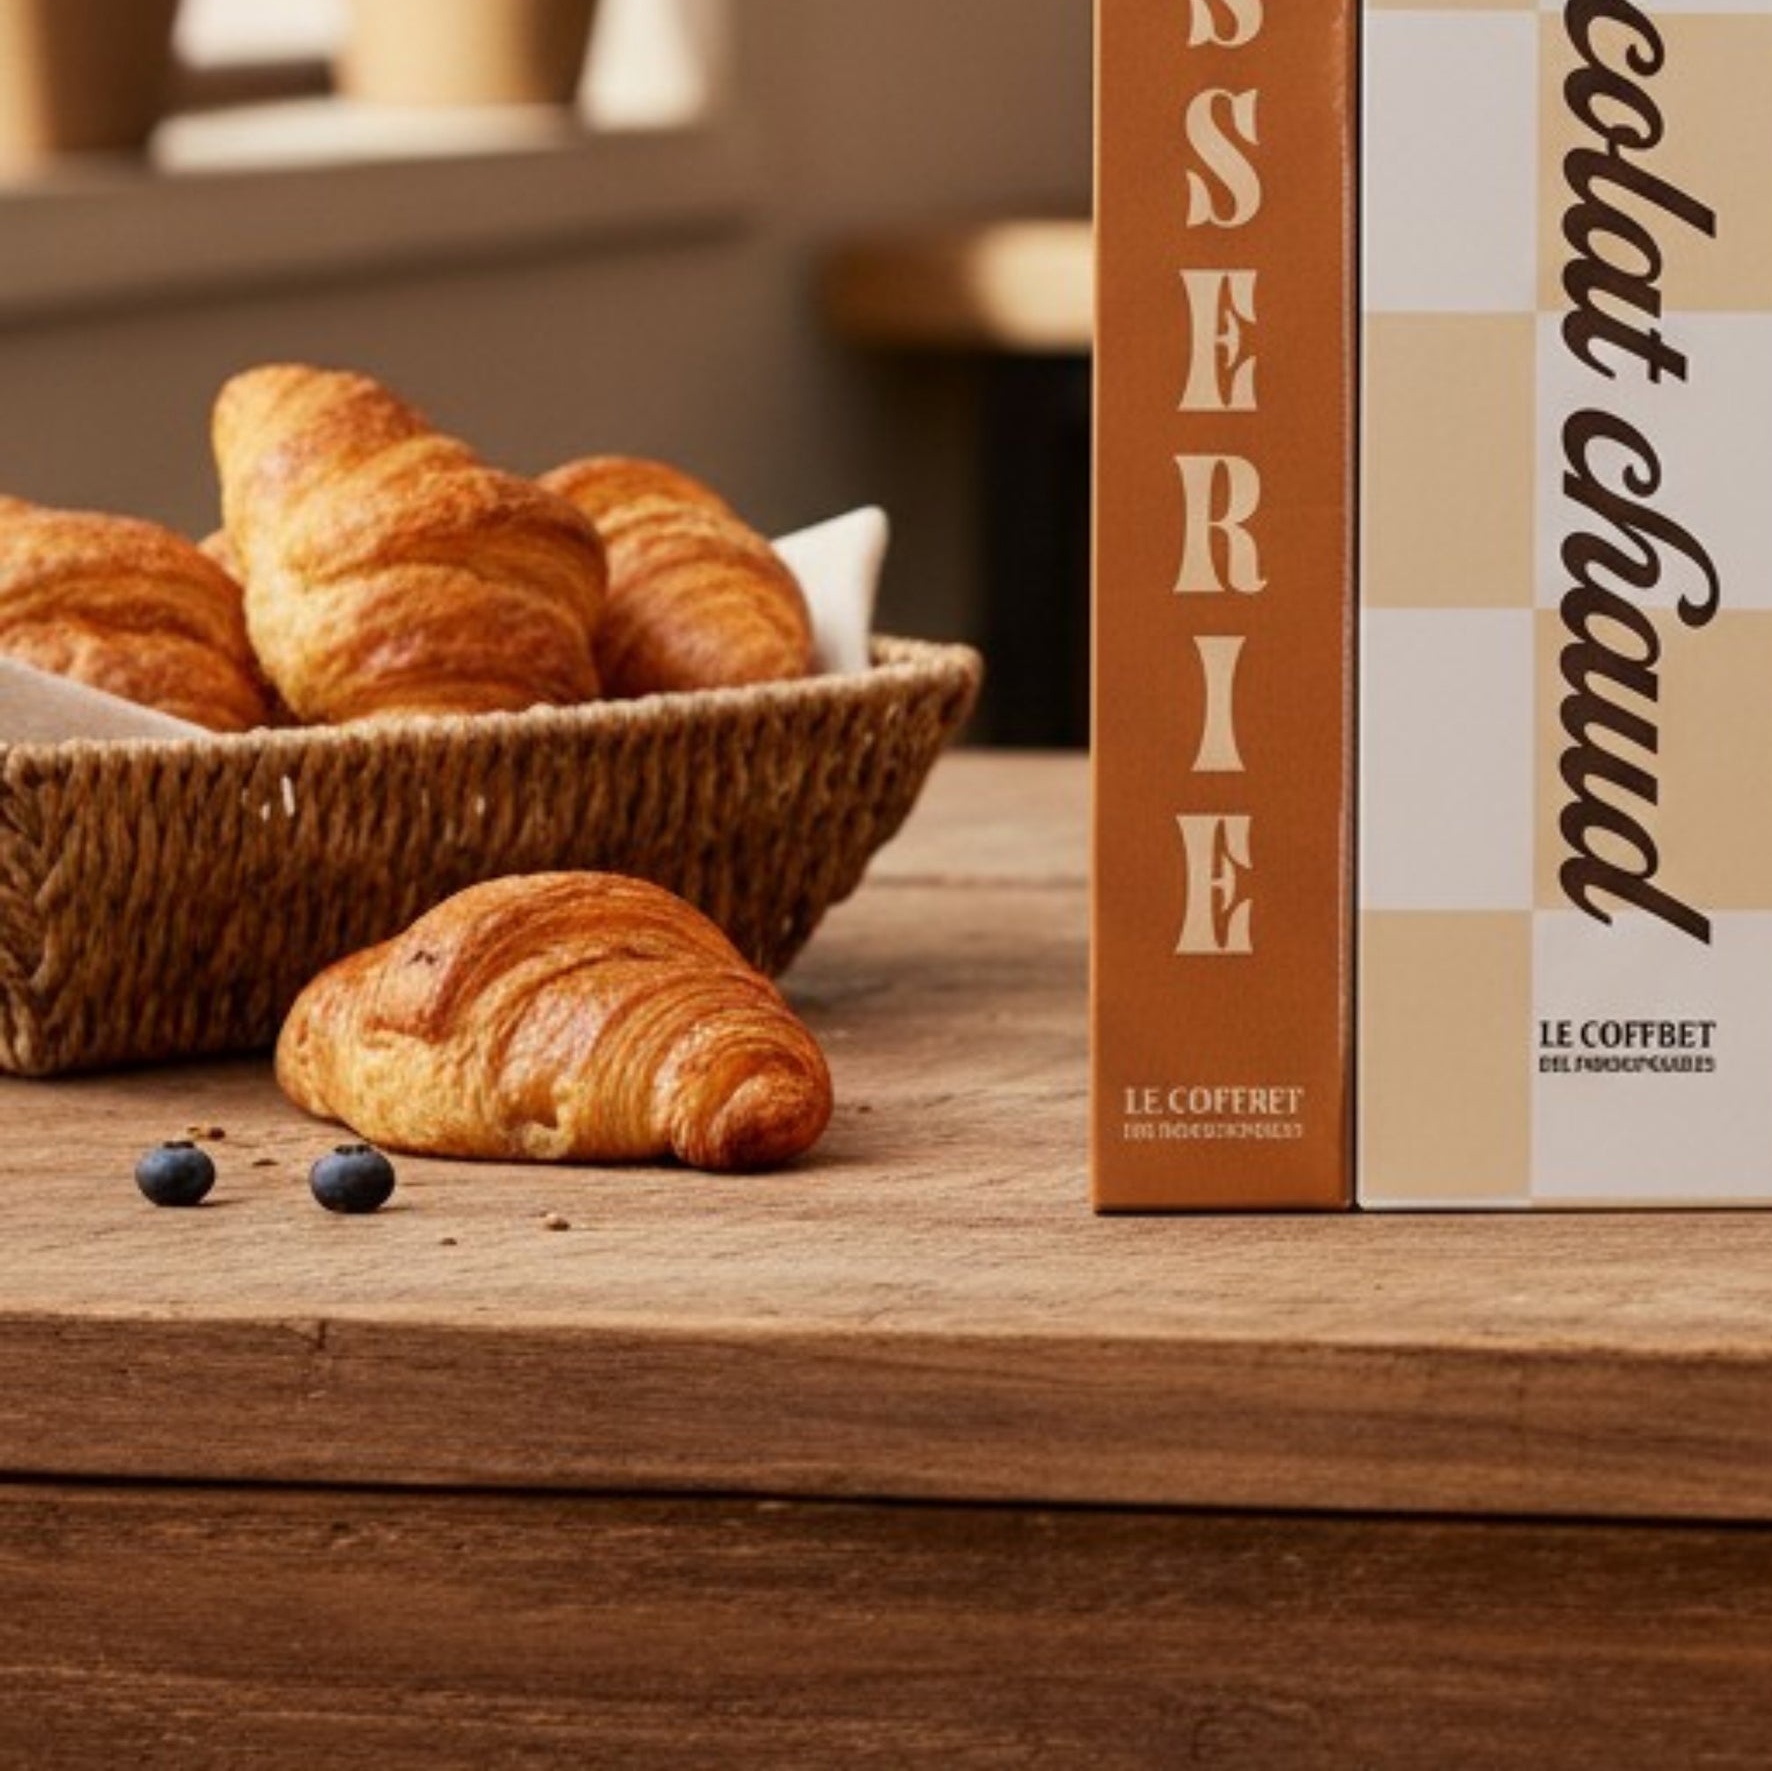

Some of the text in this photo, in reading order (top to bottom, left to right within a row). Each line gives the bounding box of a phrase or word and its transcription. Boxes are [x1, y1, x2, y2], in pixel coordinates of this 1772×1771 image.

[1558, 408, 1720, 945] chaud
[1539, 1020, 1573, 1048] LE
[1124, 1087, 1163, 1115] LE
